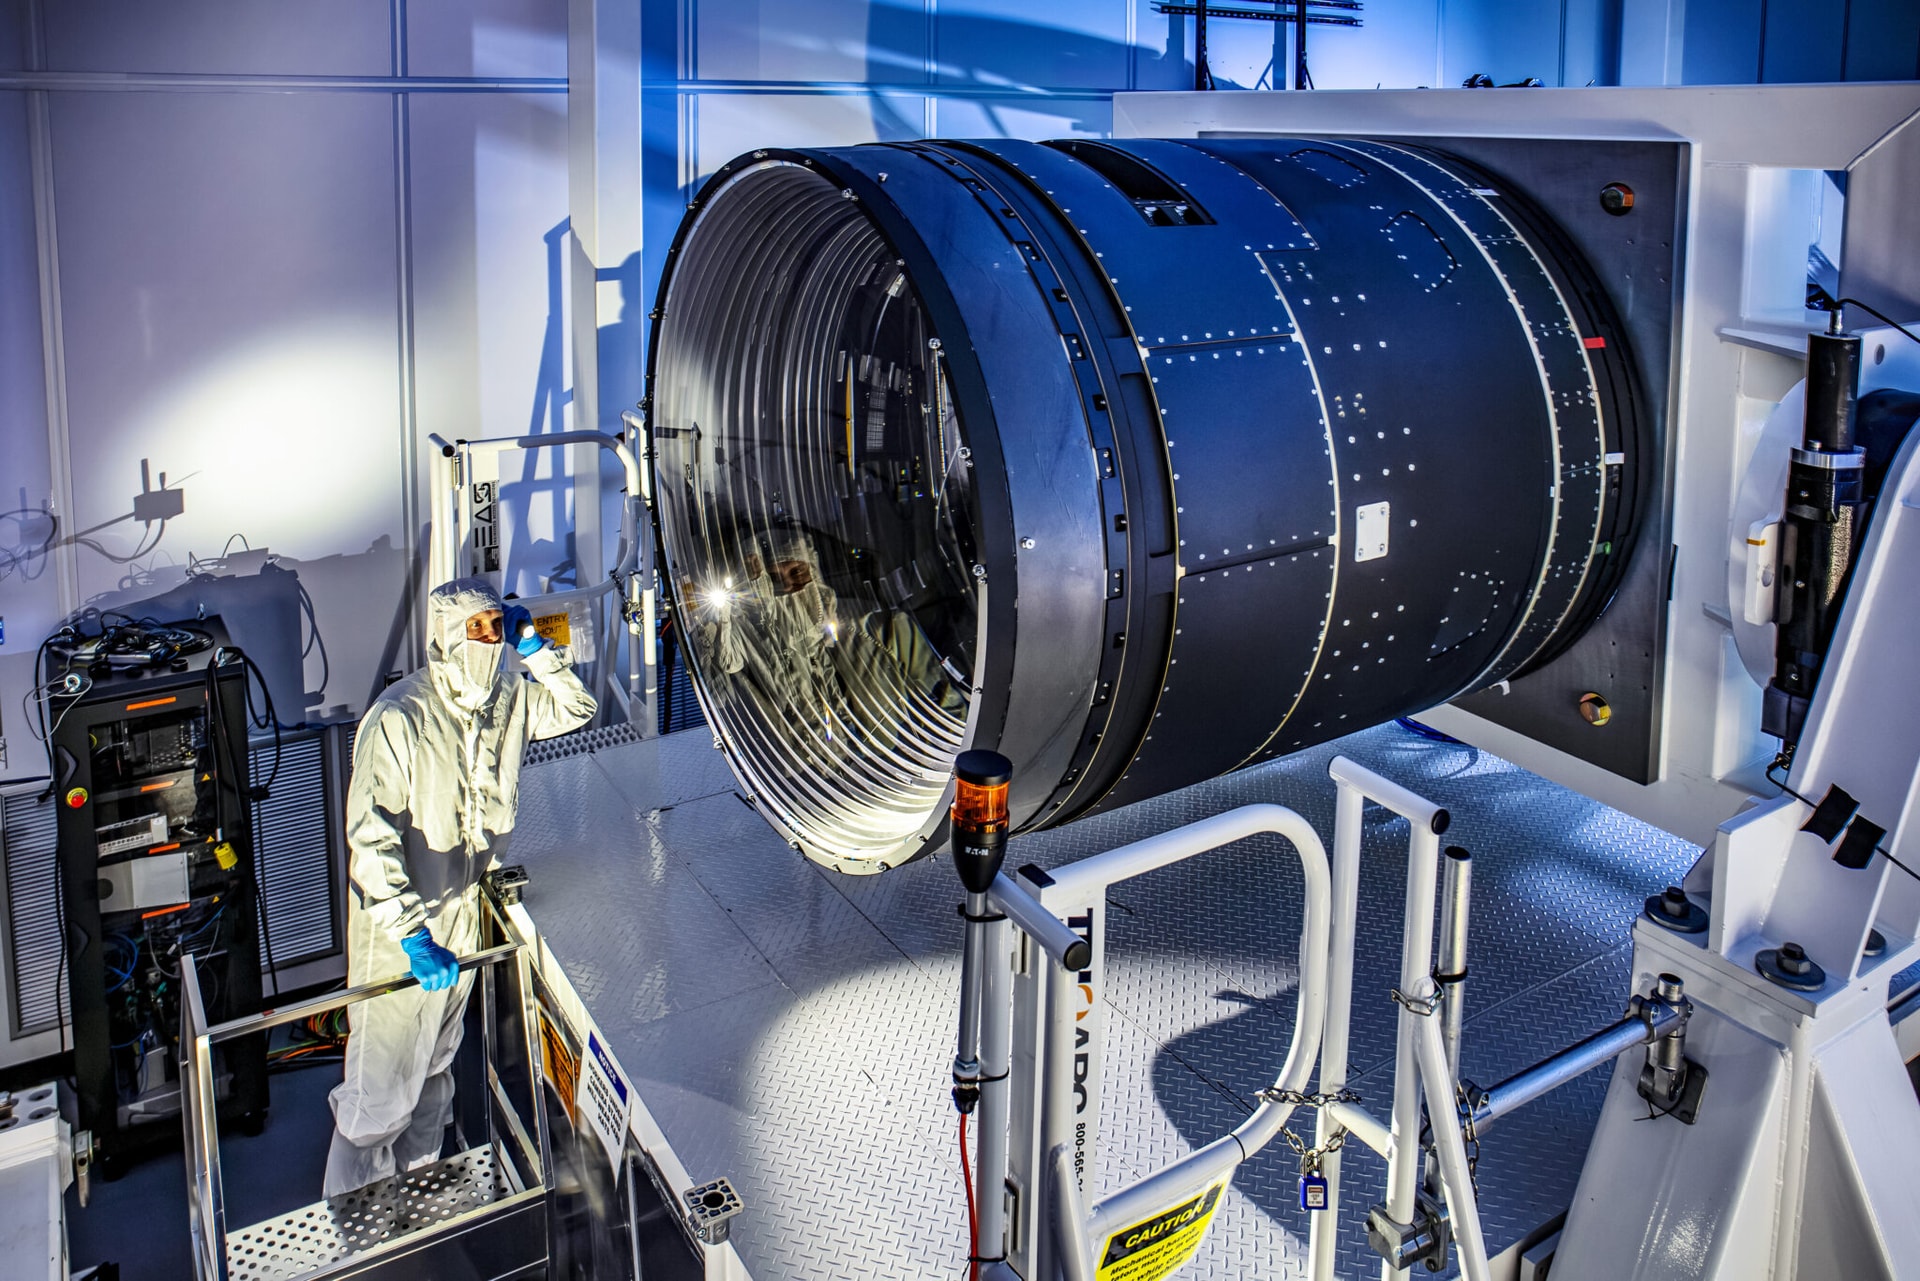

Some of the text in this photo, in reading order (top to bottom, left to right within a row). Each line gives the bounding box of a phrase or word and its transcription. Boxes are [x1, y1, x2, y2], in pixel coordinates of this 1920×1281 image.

[474, 483, 492, 548] EAS
[536, 614, 566, 626] ENTRY
[599, 1050, 617, 1084] NOTICE
[587, 1083, 597, 1104] WILL
[598, 1100, 610, 1125] WEAR
[588, 1060, 623, 1123] WORKERS UNDER
[590, 1075, 621, 1132] CAMERA STAND
[598, 1113, 610, 1136] HATS
[1125, 1200, 1205, 1248] CAUTION
[1110, 1244, 1164, 1276] Mechanical
